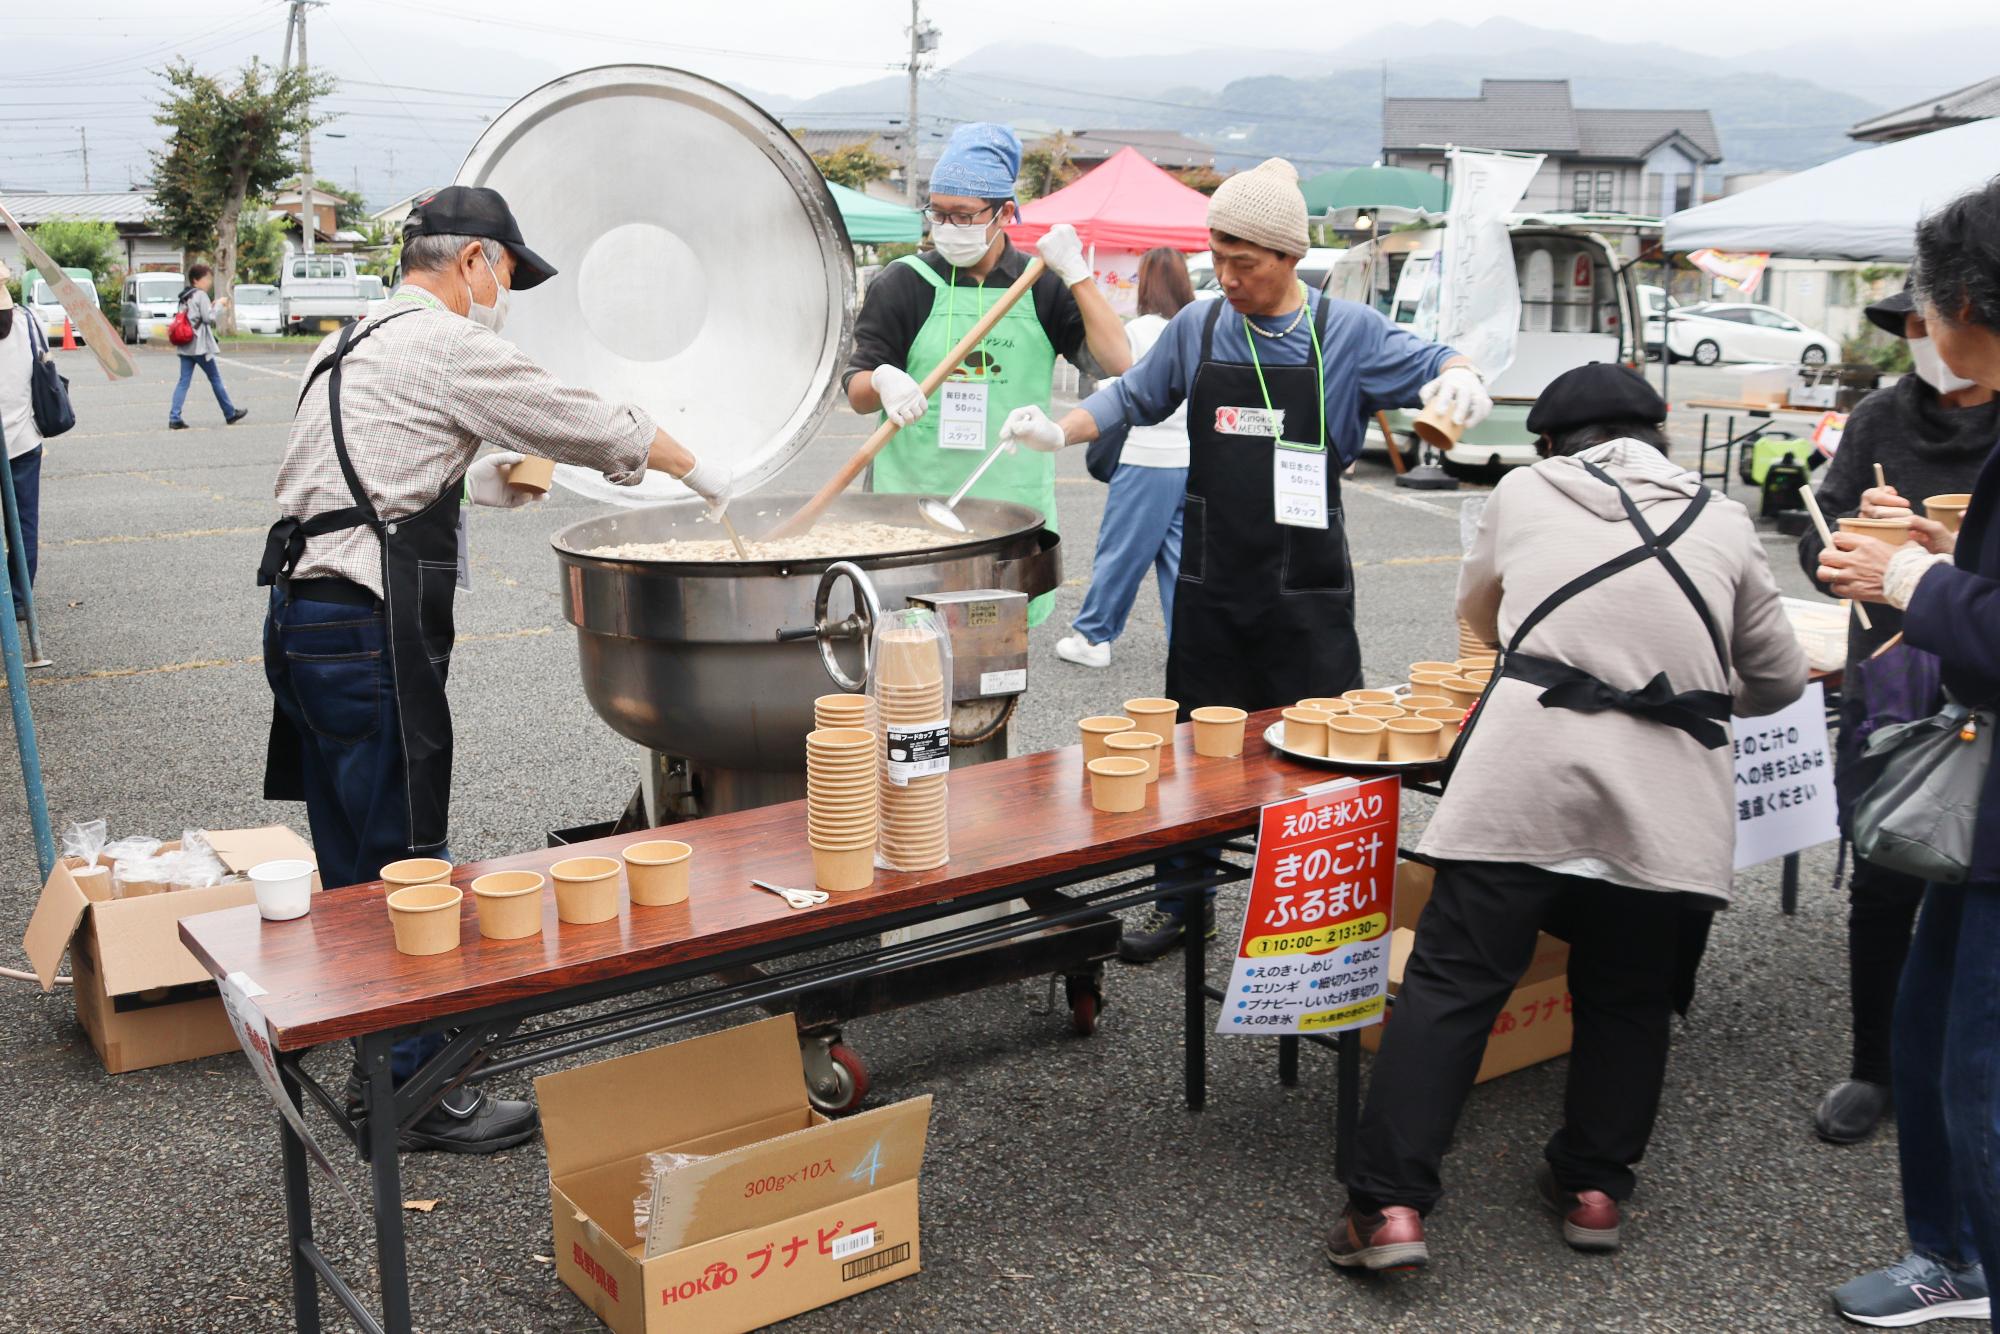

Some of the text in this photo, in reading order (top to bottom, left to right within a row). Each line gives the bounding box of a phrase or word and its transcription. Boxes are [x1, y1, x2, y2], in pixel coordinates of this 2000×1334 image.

[1281, 794, 1383, 839] えのき氷入り
[1273, 832, 1384, 888] きのこ汁
[1264, 877, 1377, 928] ふるまい
[1351, 947, 1381, 965] なめこ
[1251, 980, 1301, 994] エリンギ
[1241, 1014, 1294, 1025] えのき氷
[847, 1140, 884, 1186] 4
[746, 1220, 878, 1279] ブナピー
